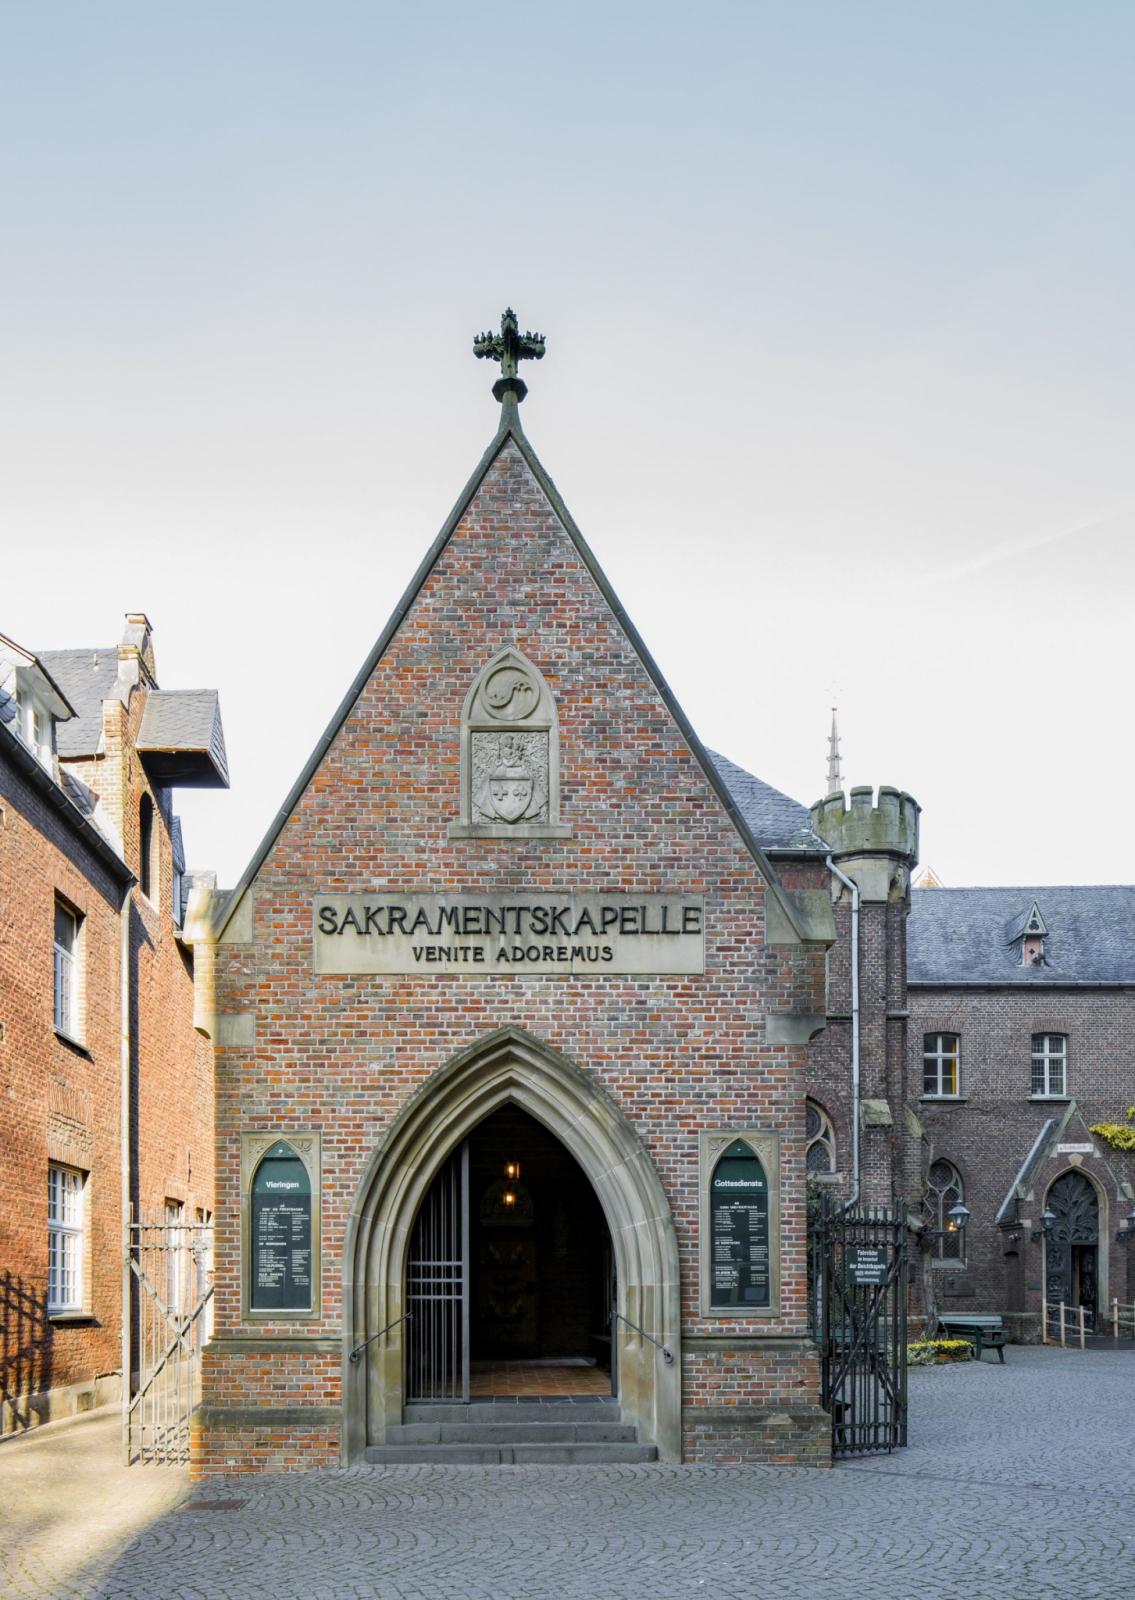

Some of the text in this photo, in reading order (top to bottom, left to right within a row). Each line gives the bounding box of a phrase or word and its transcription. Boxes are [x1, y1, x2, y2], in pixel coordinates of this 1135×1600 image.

[318, 906, 702, 936] SAKRAMENTSKAPELLE
[412, 946, 614, 963] VENITE ADOREMUS
[266, 1181, 299, 1189] Vieringen
[714, 1179, 763, 1187] Gottesdienste
